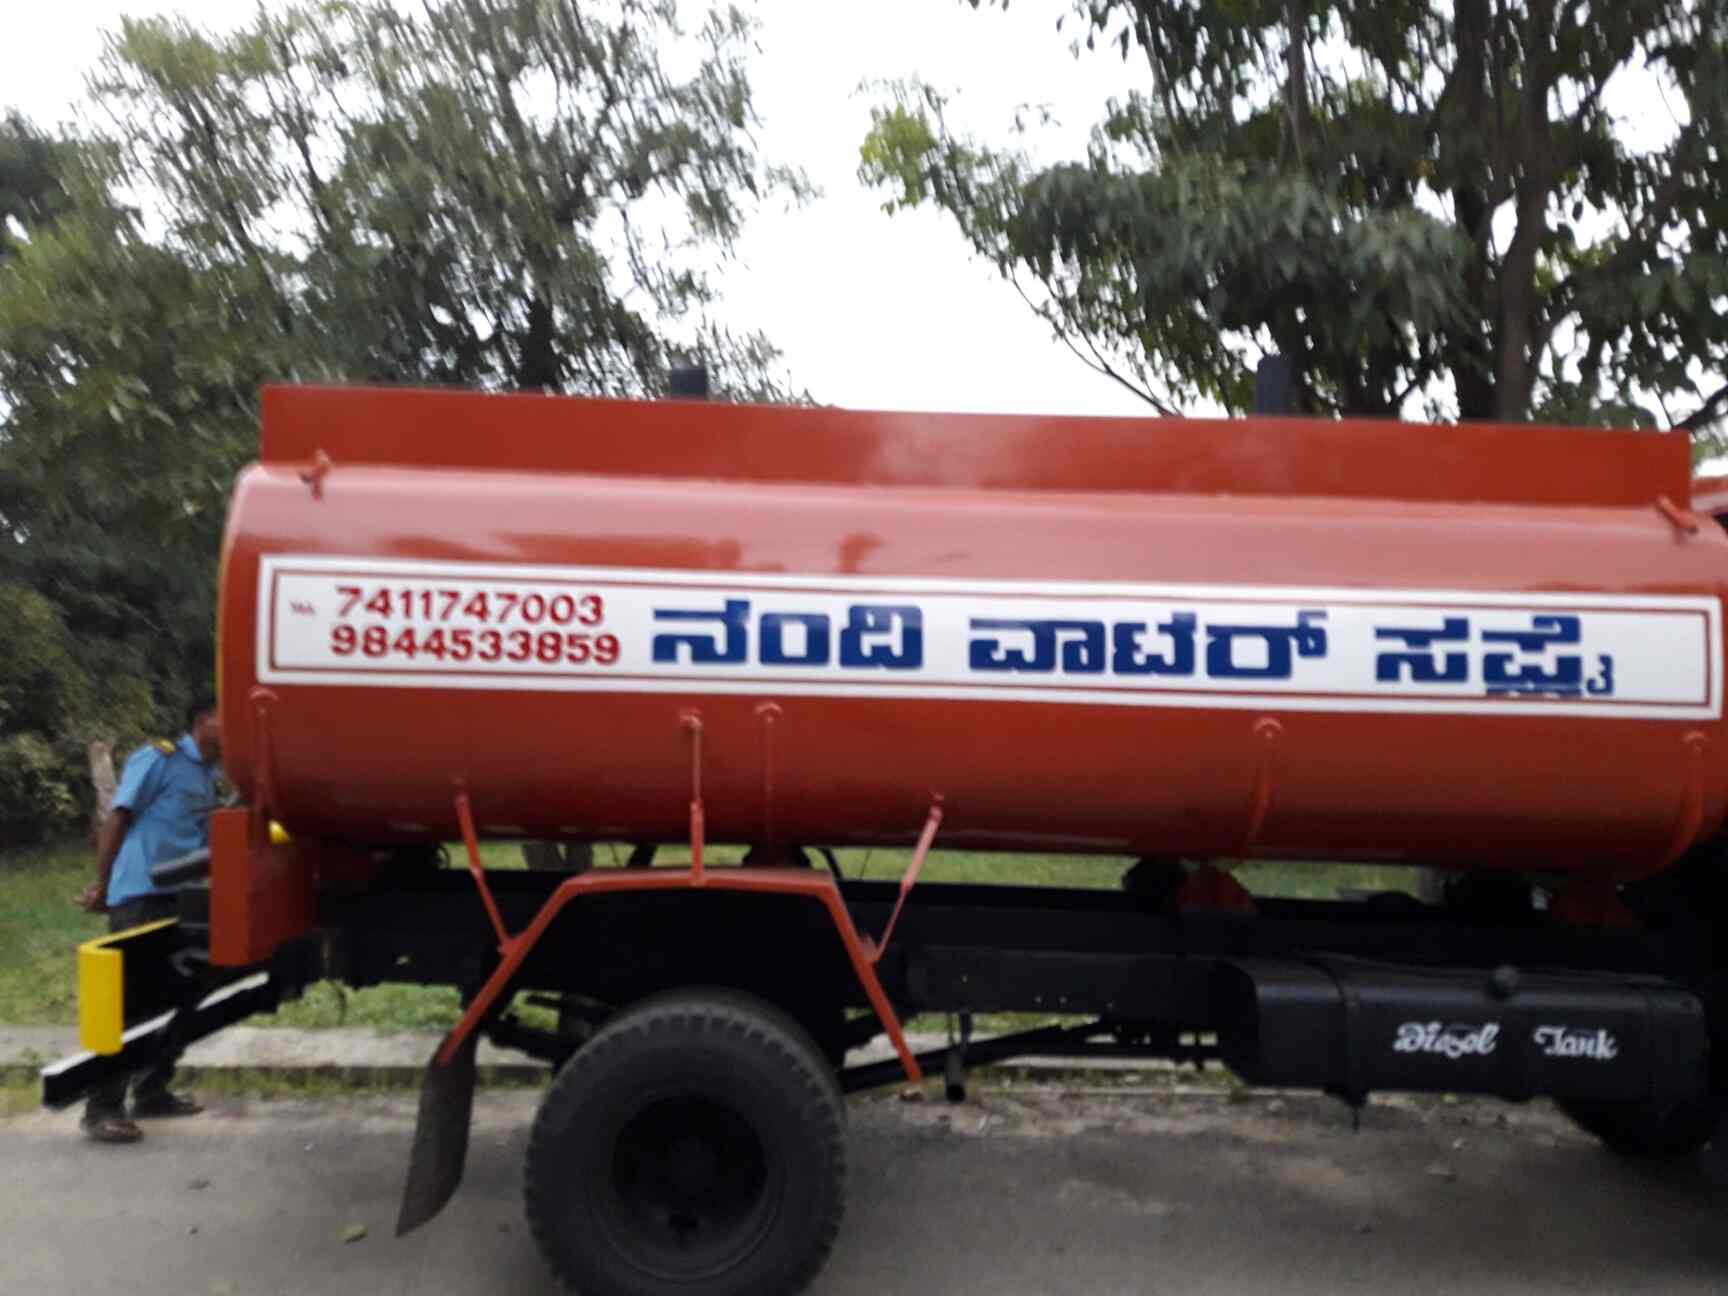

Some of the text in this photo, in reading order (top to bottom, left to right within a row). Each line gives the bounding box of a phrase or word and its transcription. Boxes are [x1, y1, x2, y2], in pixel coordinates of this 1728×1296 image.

[334, 586, 605, 625] 7411747003
[330, 625, 621, 666] 9844533859
[652, 599, 1615, 698] ನಂದಿ ವಾಟರ್ ಸಪ್ಲೈ
[1393, 1021, 1617, 1059] Diesel Tank
